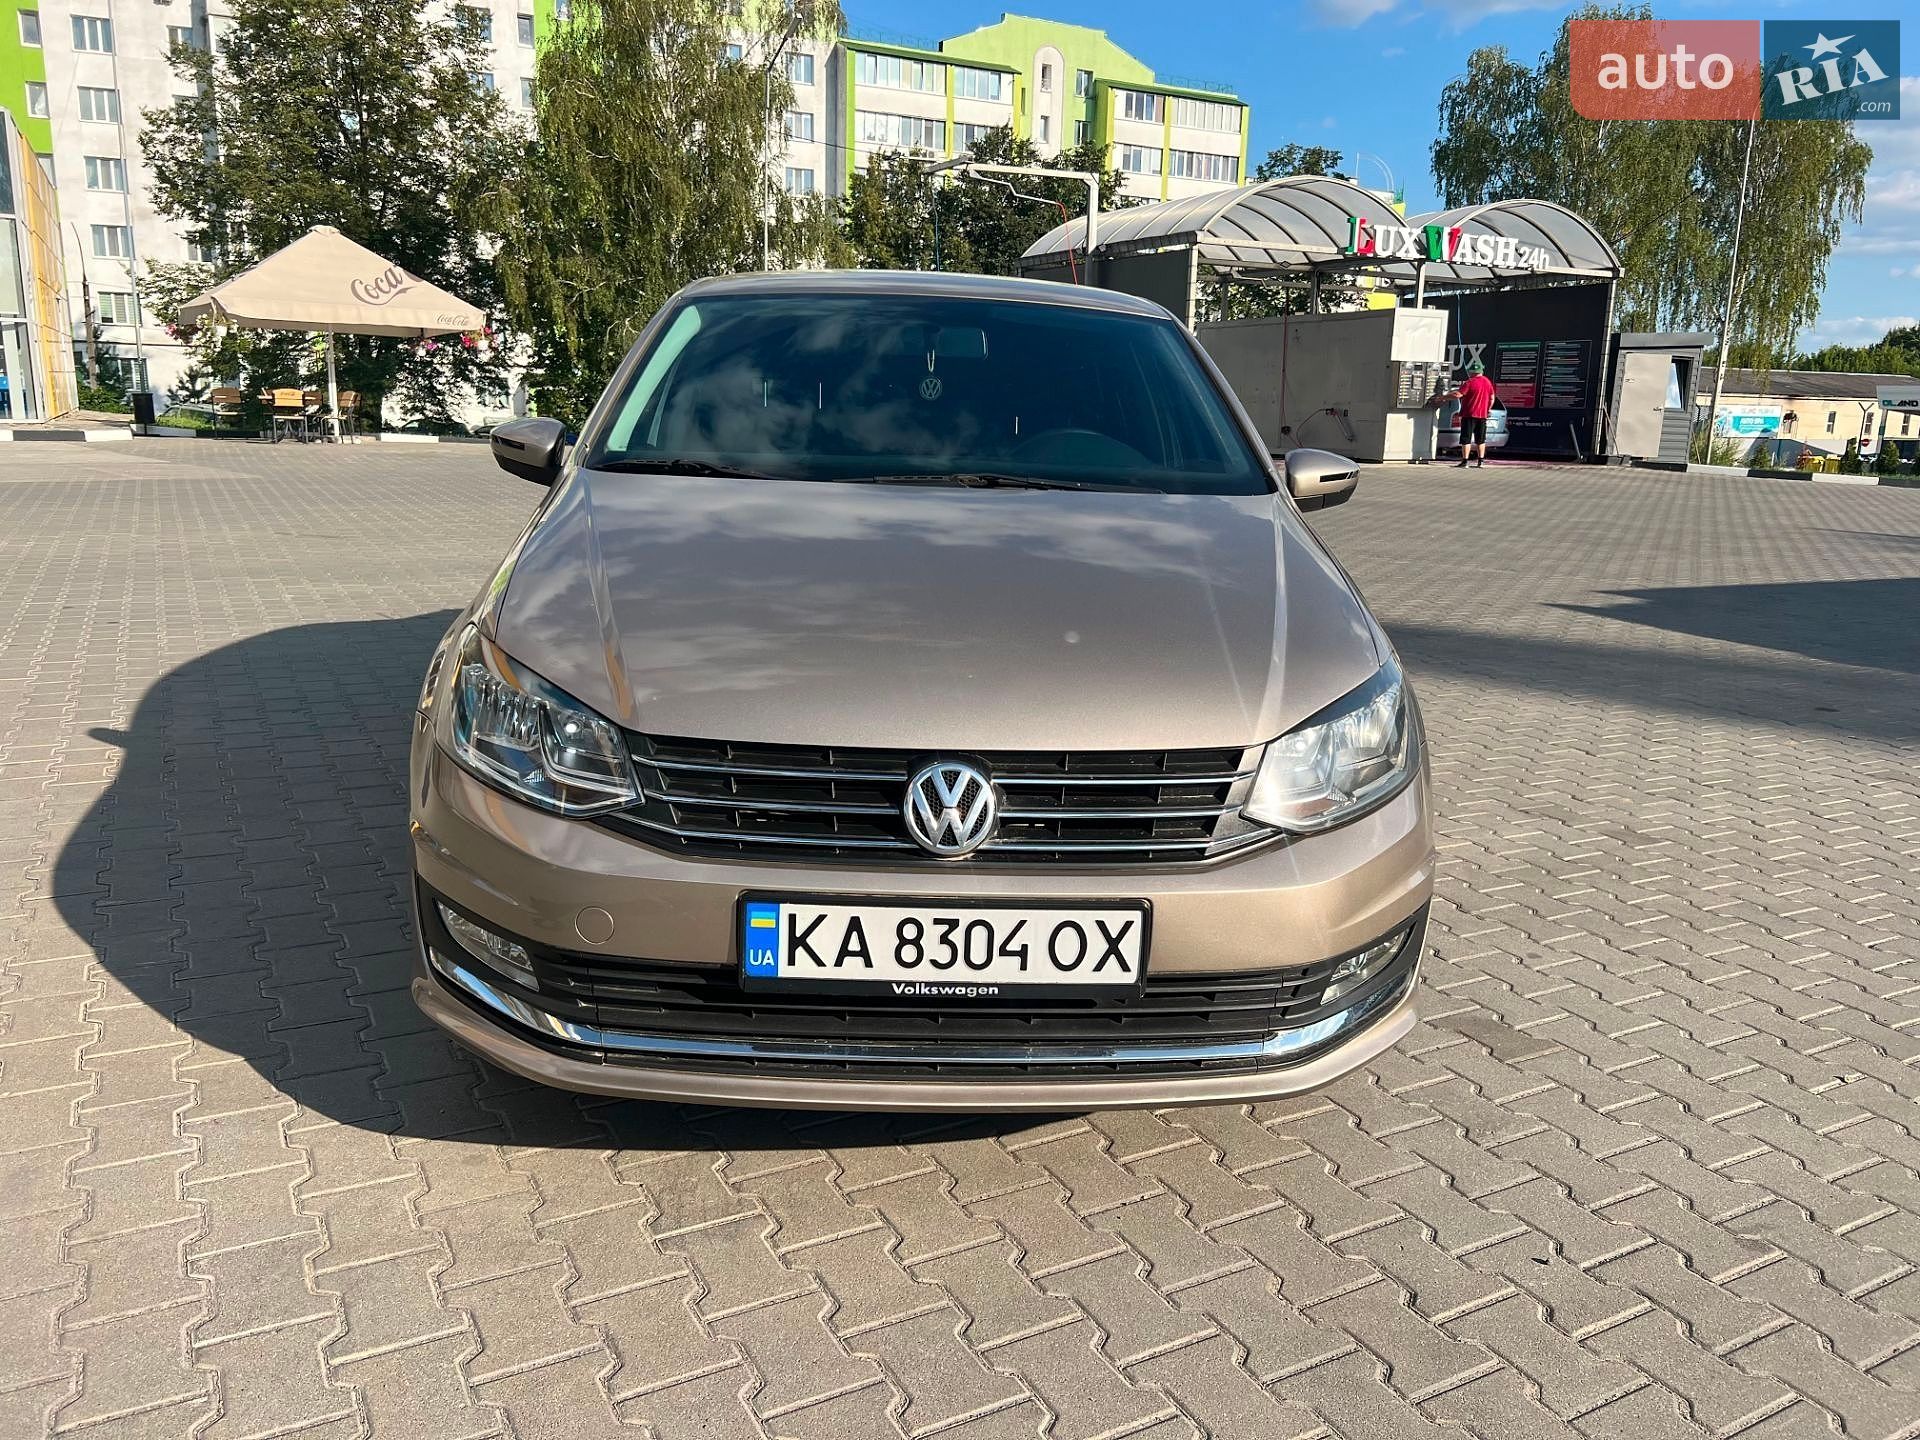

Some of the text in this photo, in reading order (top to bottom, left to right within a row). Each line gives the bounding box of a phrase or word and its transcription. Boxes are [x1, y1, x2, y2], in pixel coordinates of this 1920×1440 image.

[1518, 246, 1550, 271] 24h
[1447, 343, 1487, 371] UX
[786, 912, 1135, 973] KA 8304 OX
[749, 949, 775, 966] UA
[891, 982, 999, 996] Volkswagen
